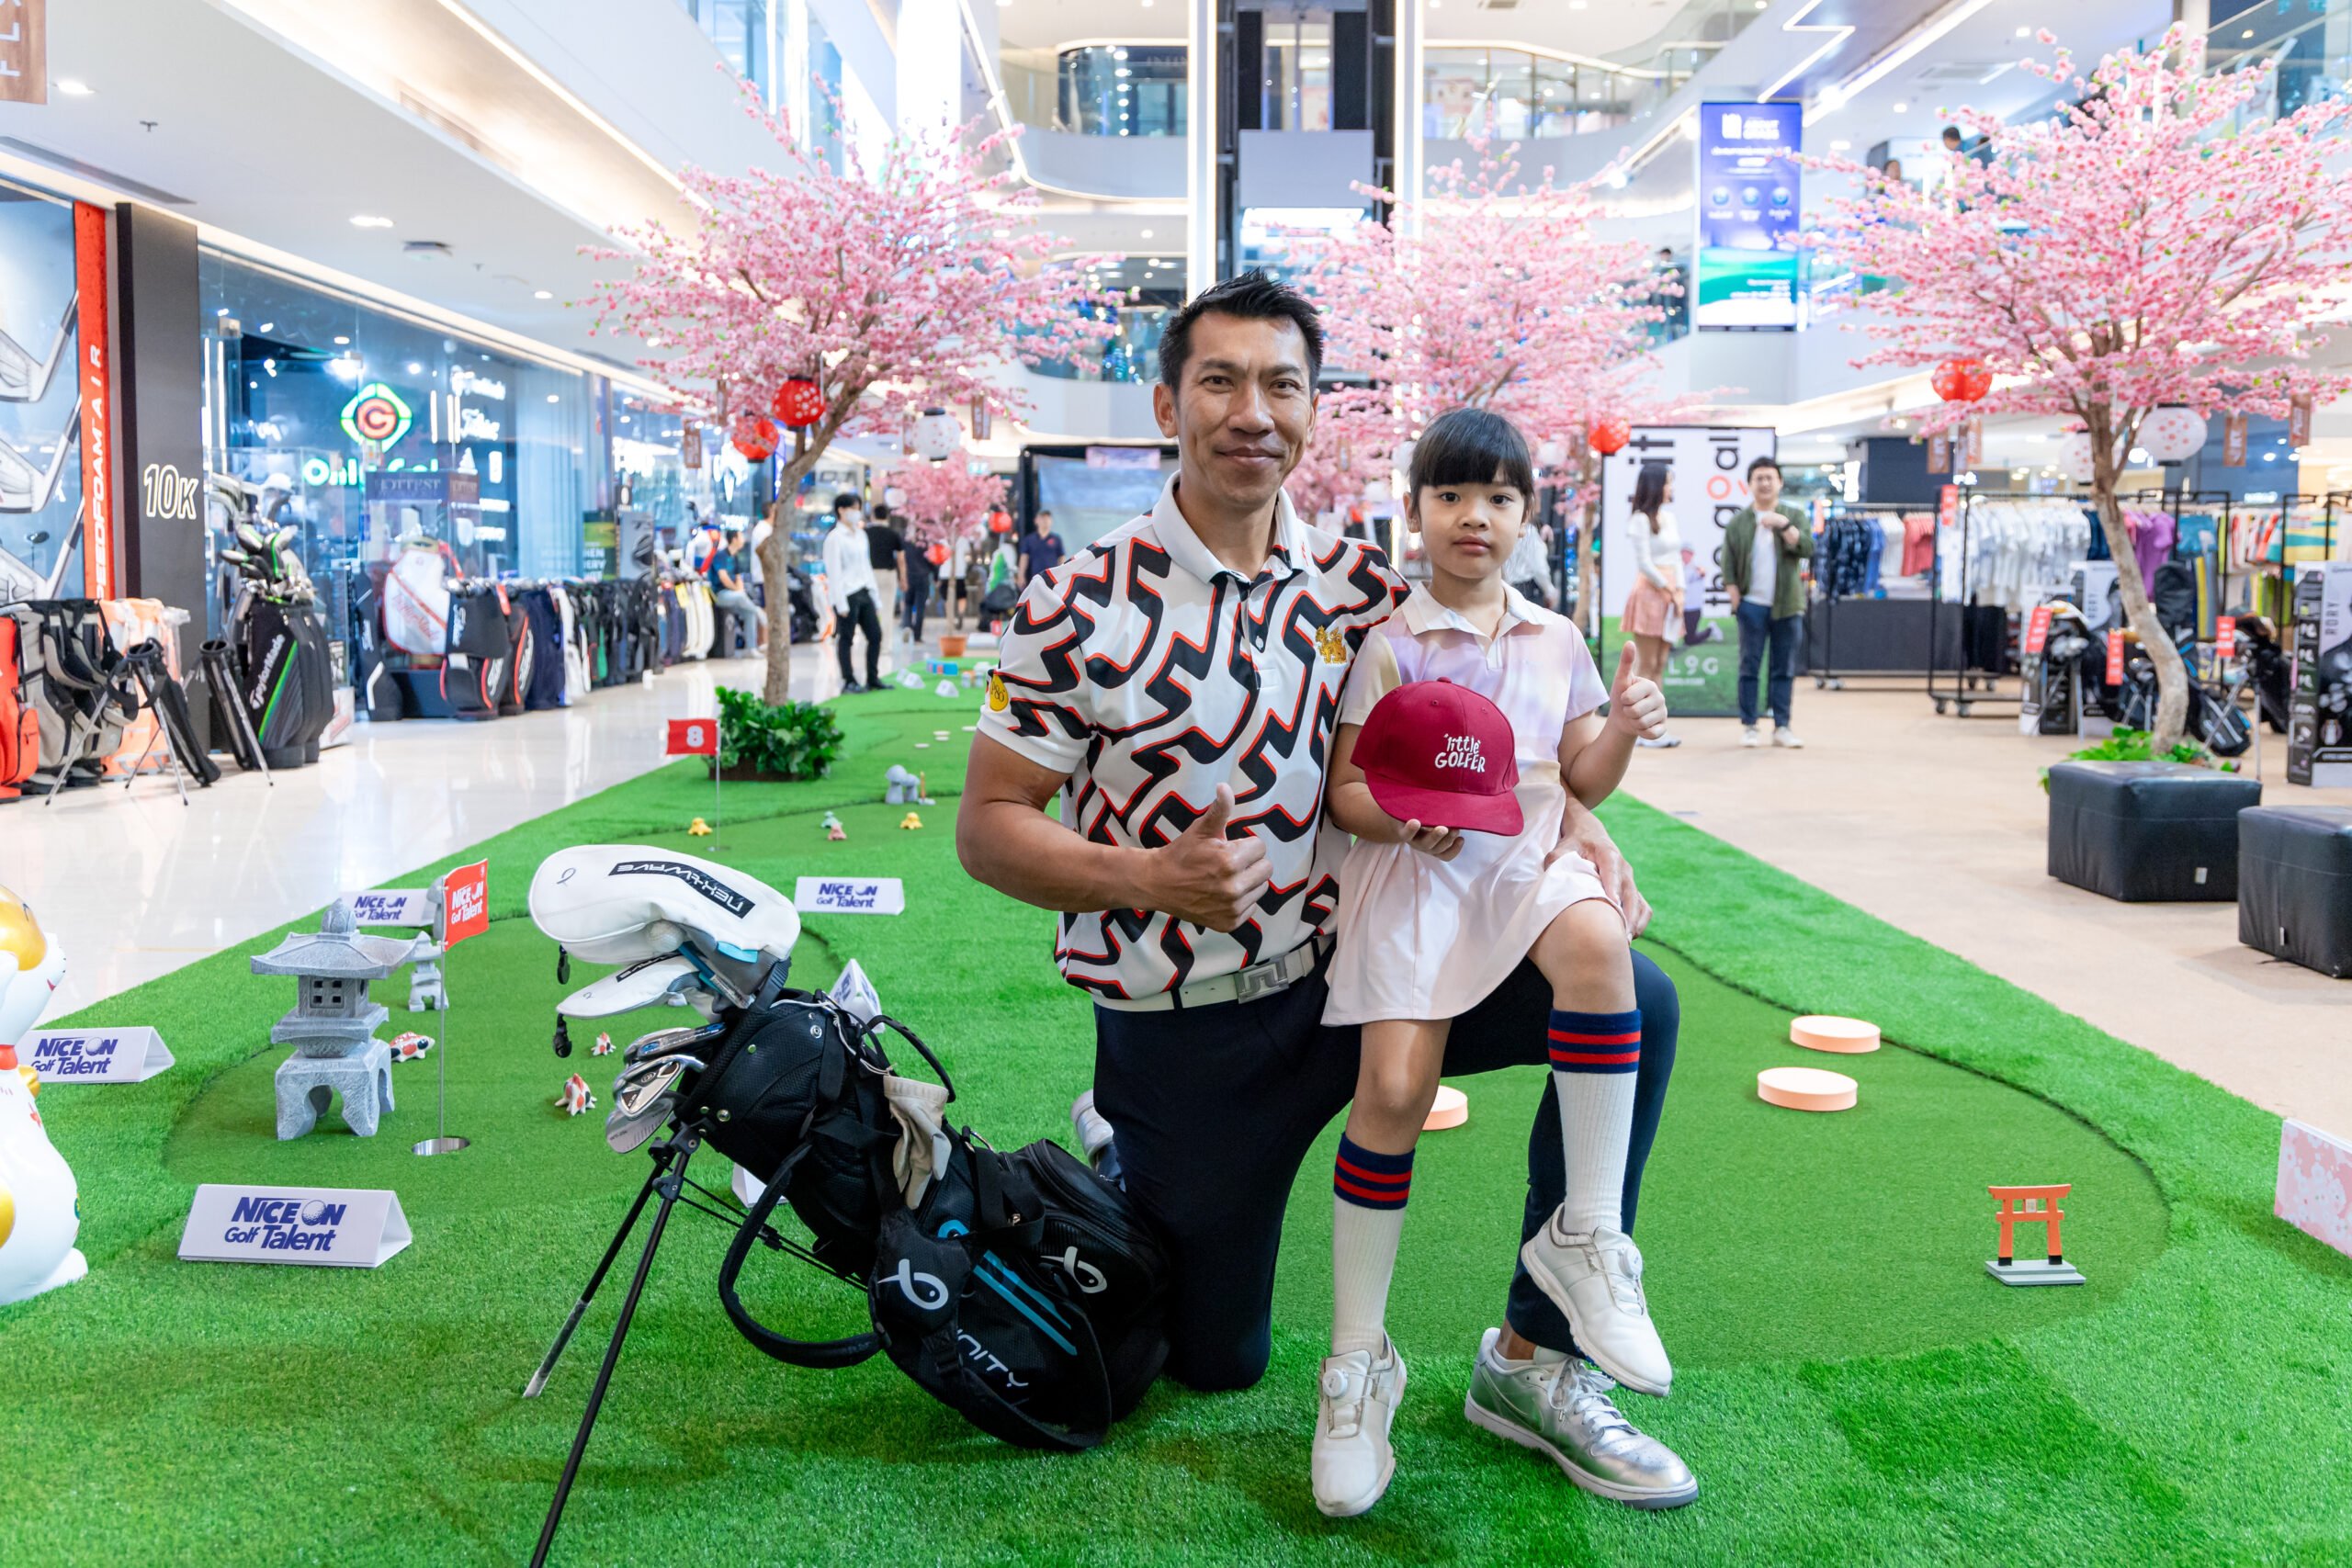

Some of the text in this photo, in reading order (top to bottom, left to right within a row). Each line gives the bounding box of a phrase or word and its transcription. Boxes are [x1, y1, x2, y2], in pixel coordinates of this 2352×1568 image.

[686, 725, 704, 747] 8
[1434, 751, 1486, 773] GOLFER
[451, 887, 470, 910] NICE
[819, 883, 877, 896] NICE ON
[354, 896, 407, 908] NICE ON
[451, 898, 483, 924] Golf Talent
[816, 896, 876, 908] Golf Talent
[367, 908, 402, 920] Talent
[34, 1037, 119, 1057] NICE ON
[56, 1055, 111, 1075] Talent
[231, 1196, 347, 1226] NICE ON
[224, 1224, 336, 1251] Golf Talent
